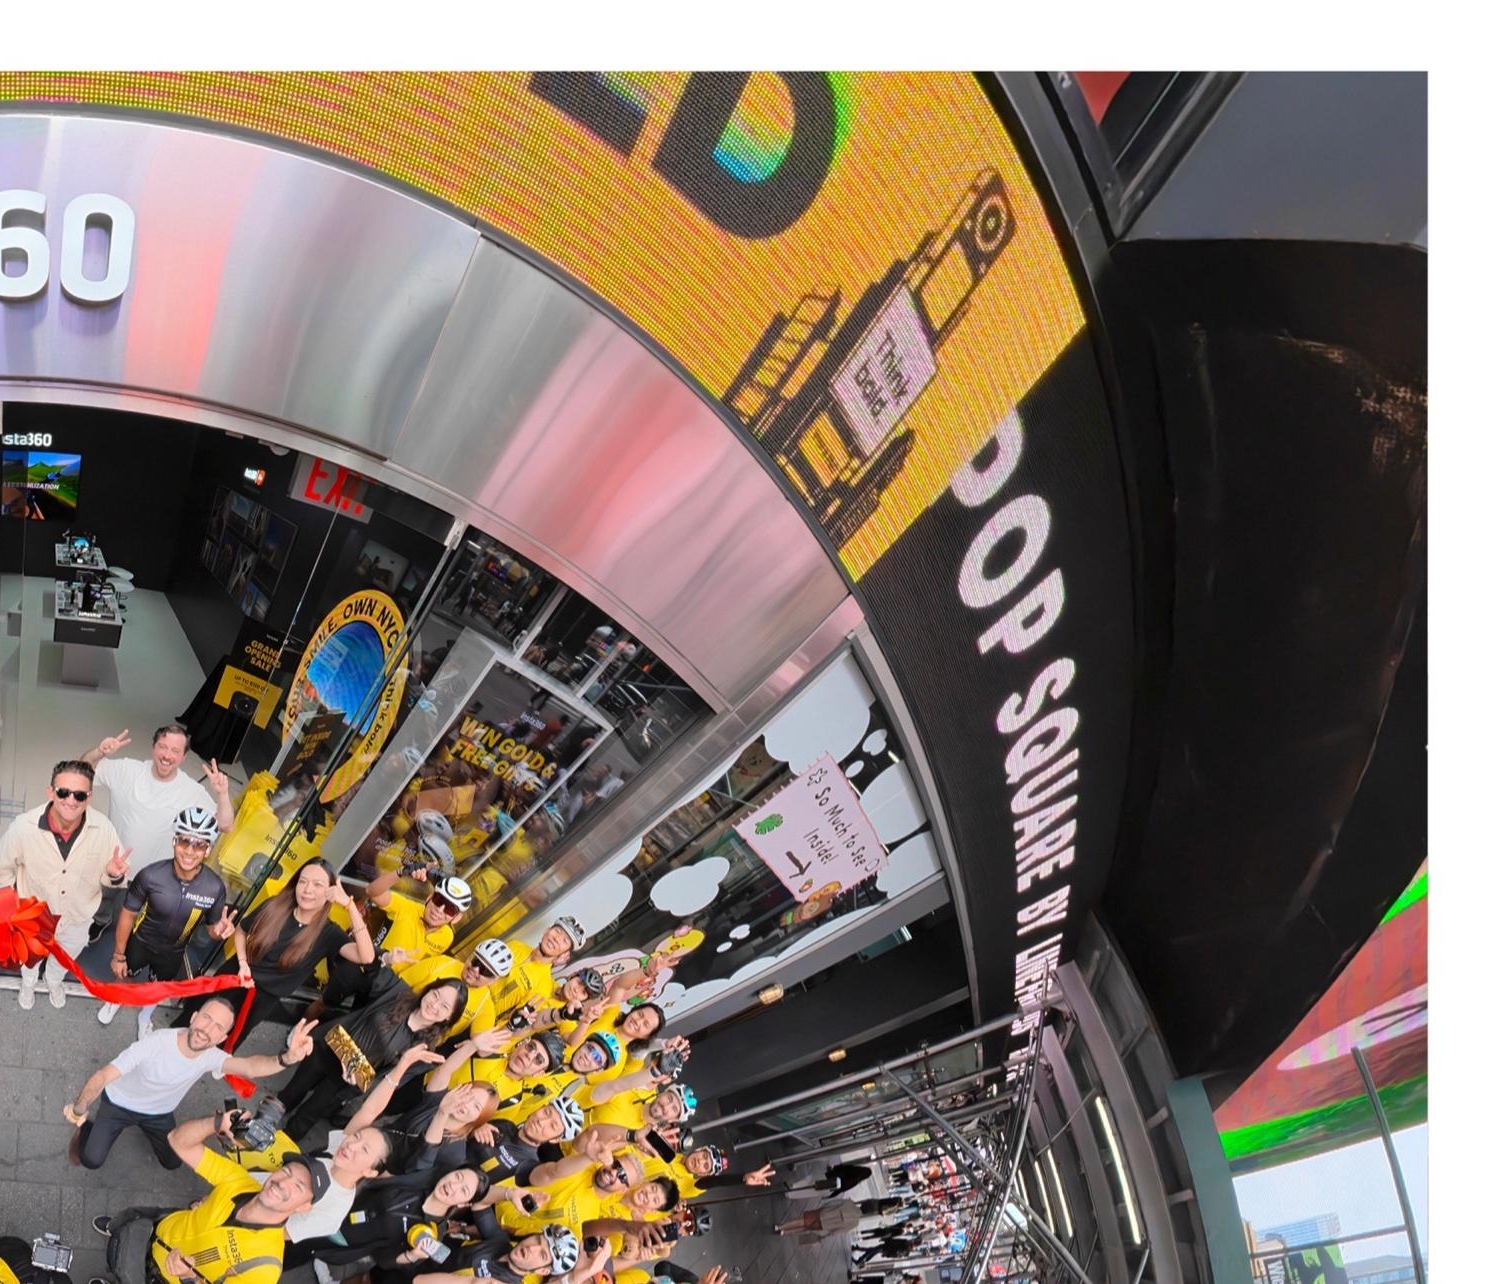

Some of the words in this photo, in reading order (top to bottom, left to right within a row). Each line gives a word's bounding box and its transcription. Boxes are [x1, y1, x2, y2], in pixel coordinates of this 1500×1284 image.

[854, 361, 891, 422] bold.
[877, 328, 909, 408] Think
[2, 432, 53, 448] sta360
[343, 598, 379, 620] OWN
[250, 656, 272, 673] SALE
[449, 739, 494, 773] FREE
[458, 714, 502, 752] WIN
[498, 733, 547, 773] GOLD
[996, 656, 1080, 894] SQUARE
[814, 786, 831, 807] So
[824, 803, 849, 839] Much
[184, 891, 217, 906] Insta360
[1014, 883, 1071, 937] BY
